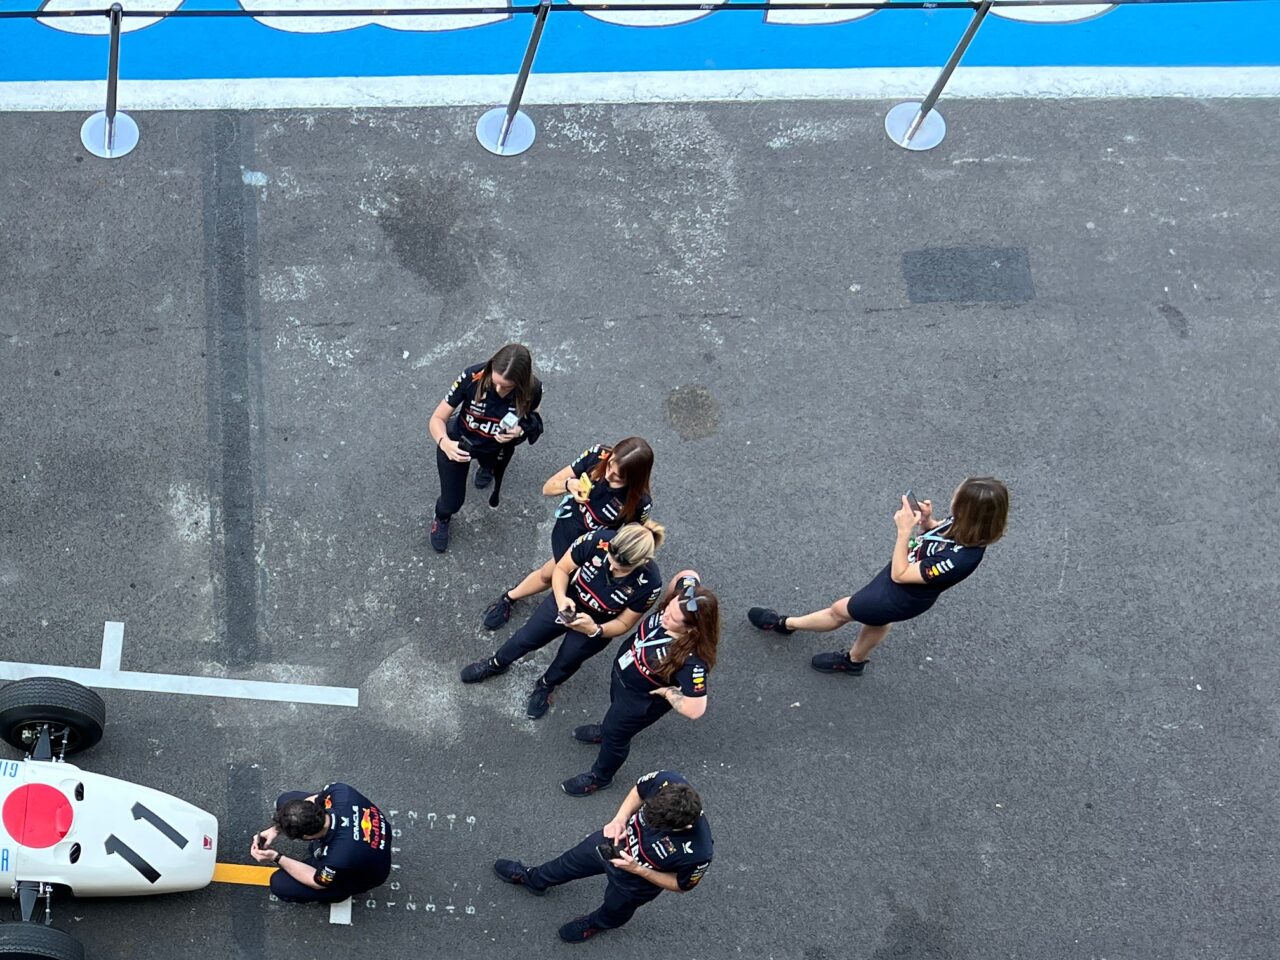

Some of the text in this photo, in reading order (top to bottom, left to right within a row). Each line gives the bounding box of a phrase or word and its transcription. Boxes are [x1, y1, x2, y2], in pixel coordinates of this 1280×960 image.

[466, 414, 492, 434] Red
[352, 805, 360, 841] ORACLE
[104, 801, 190, 885] 11
